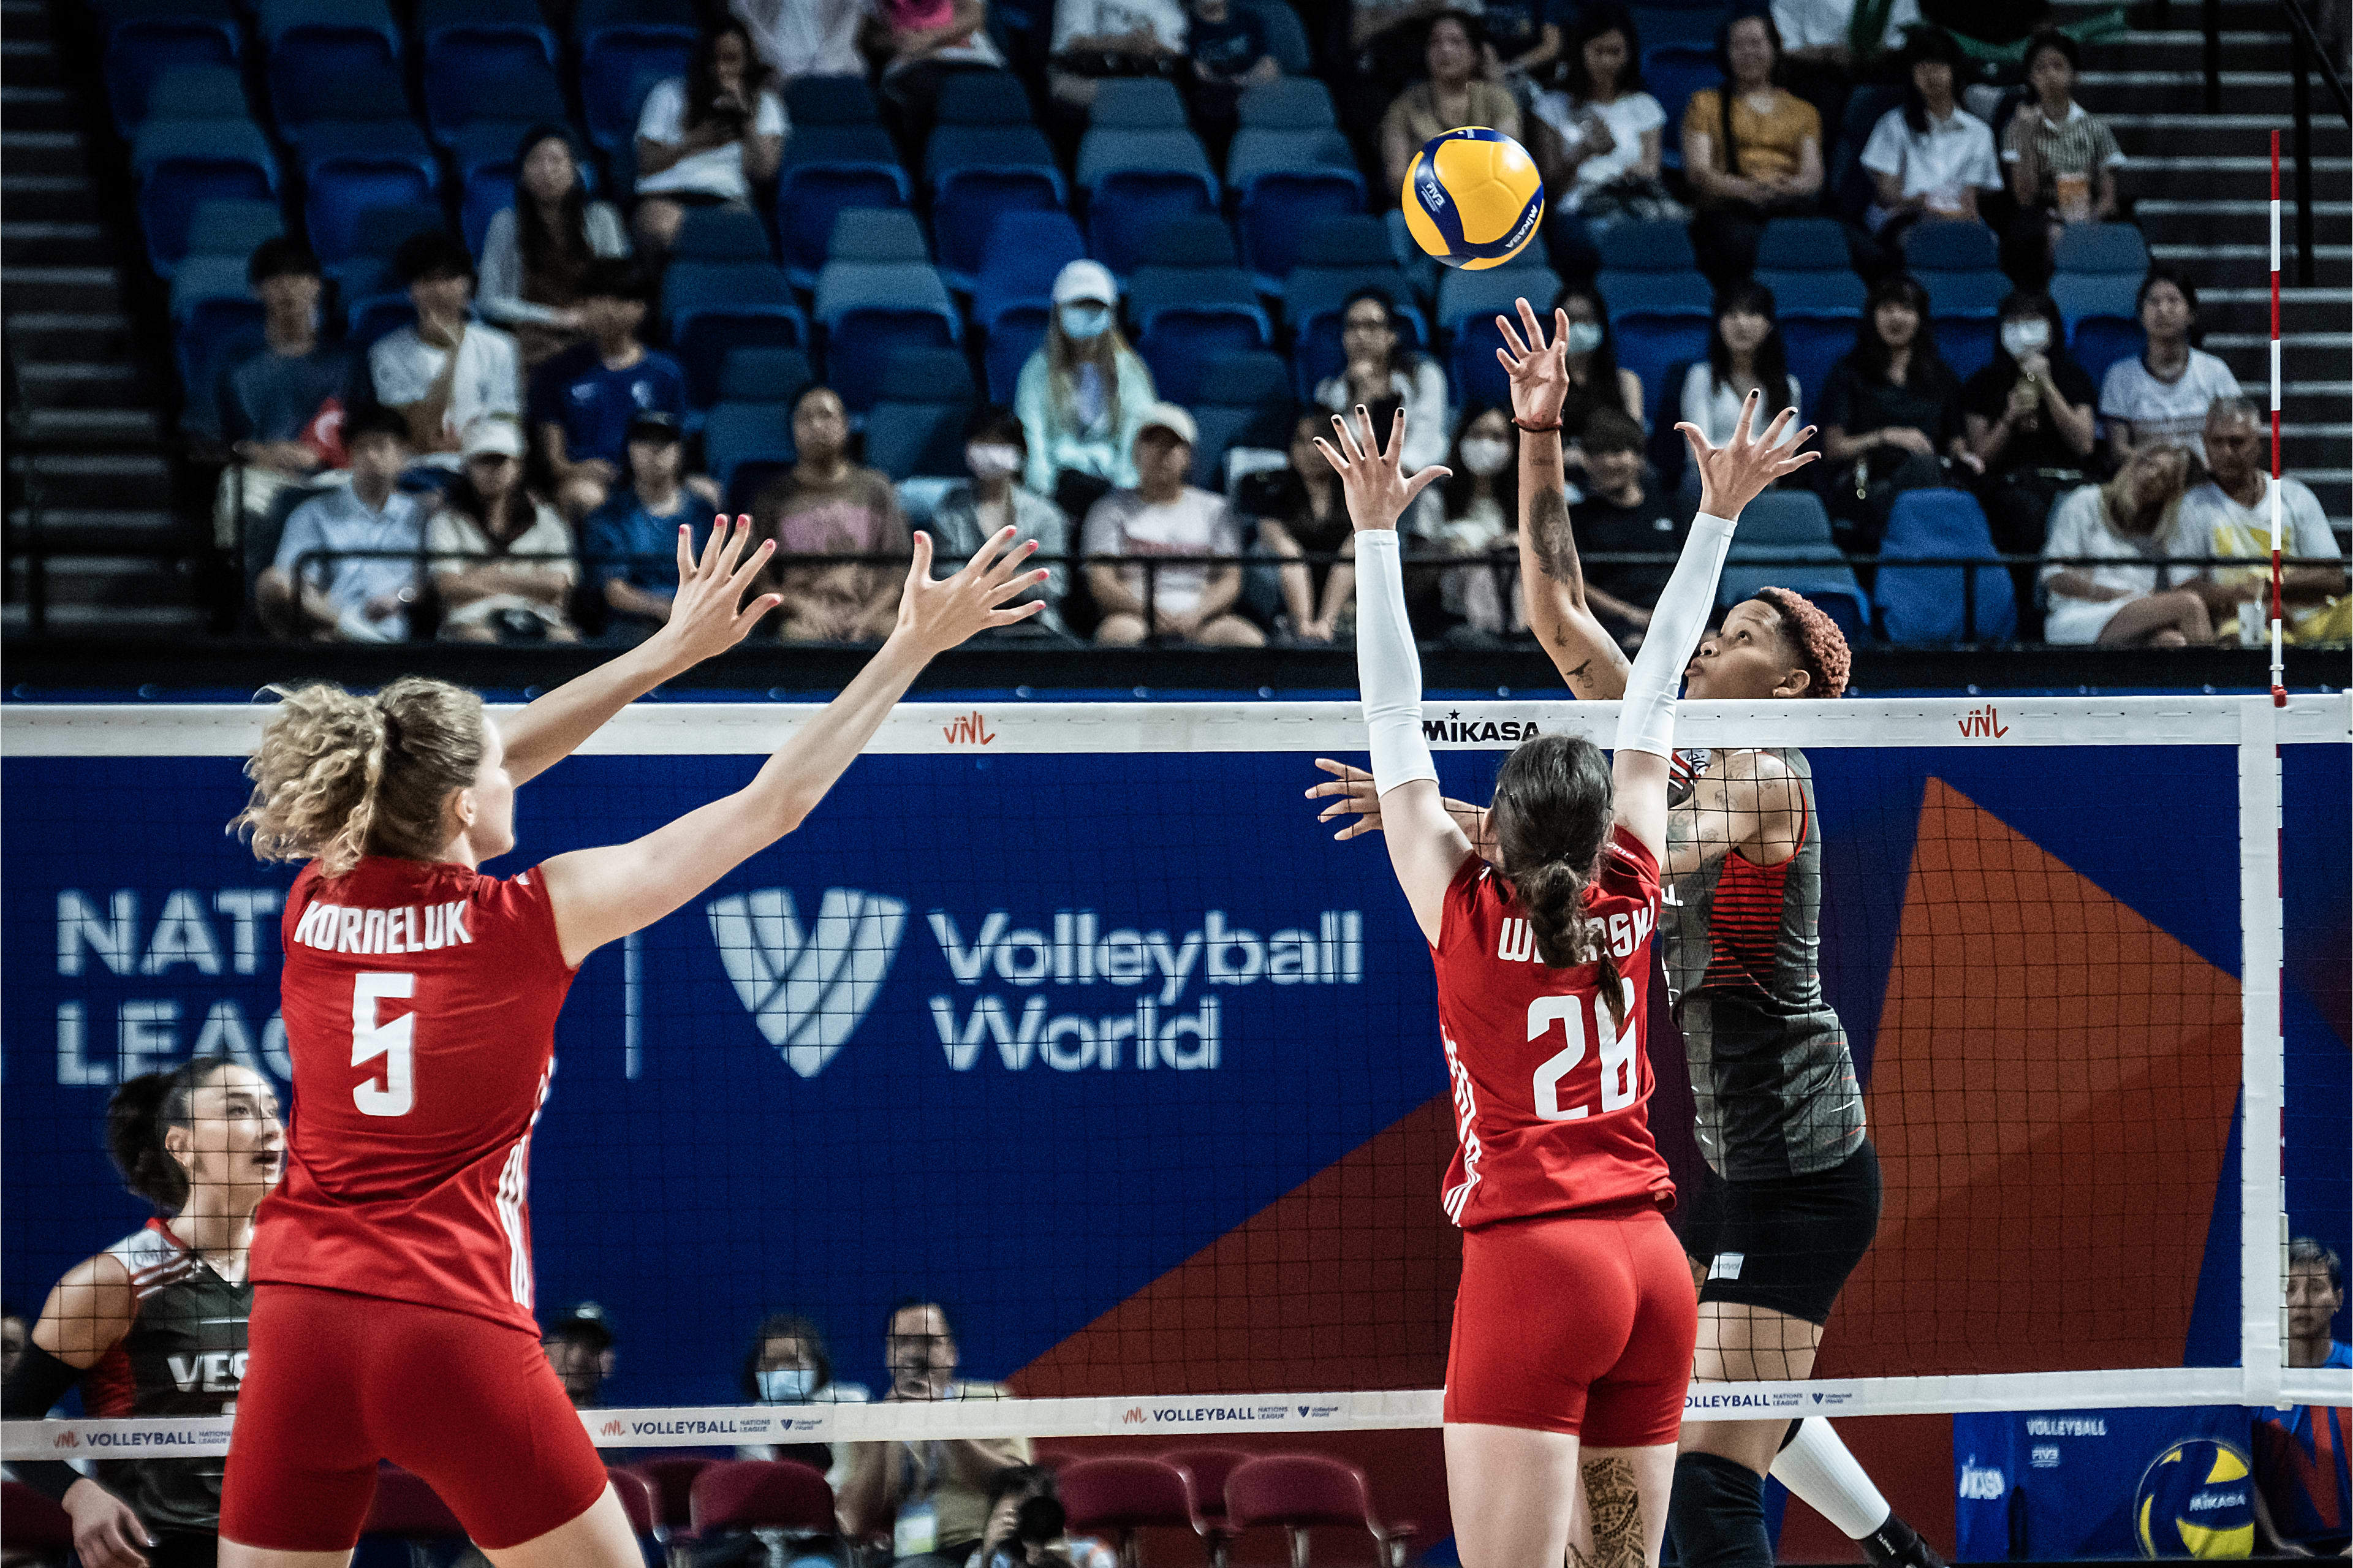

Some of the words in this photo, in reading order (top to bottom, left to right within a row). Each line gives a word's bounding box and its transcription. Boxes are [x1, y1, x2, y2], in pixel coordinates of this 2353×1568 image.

[1505, 205, 1538, 248] MIKASA
[943, 710, 996, 745] VNL
[1422, 713, 1540, 742] MIKASA
[1958, 704, 2009, 738] VNL
[57, 889, 287, 975] NAT
[294, 901, 473, 954] KORNELUK
[926, 909, 1364, 1005] Volleyball
[351, 972, 415, 1116] 5
[929, 994, 1221, 1071] World
[1528, 977, 1638, 1120] 26
[1153, 1408, 1255, 1422] VOLLEYBALL
[1684, 1395, 1770, 1407] OLLEYBALL
[86, 1431, 195, 1447] VOLLEYBALL
[632, 1420, 737, 1435] VOLLEYBALL
[2026, 1418, 2107, 1436] VOLLEYBALL
[2189, 1491, 2245, 1512] MIKASA
